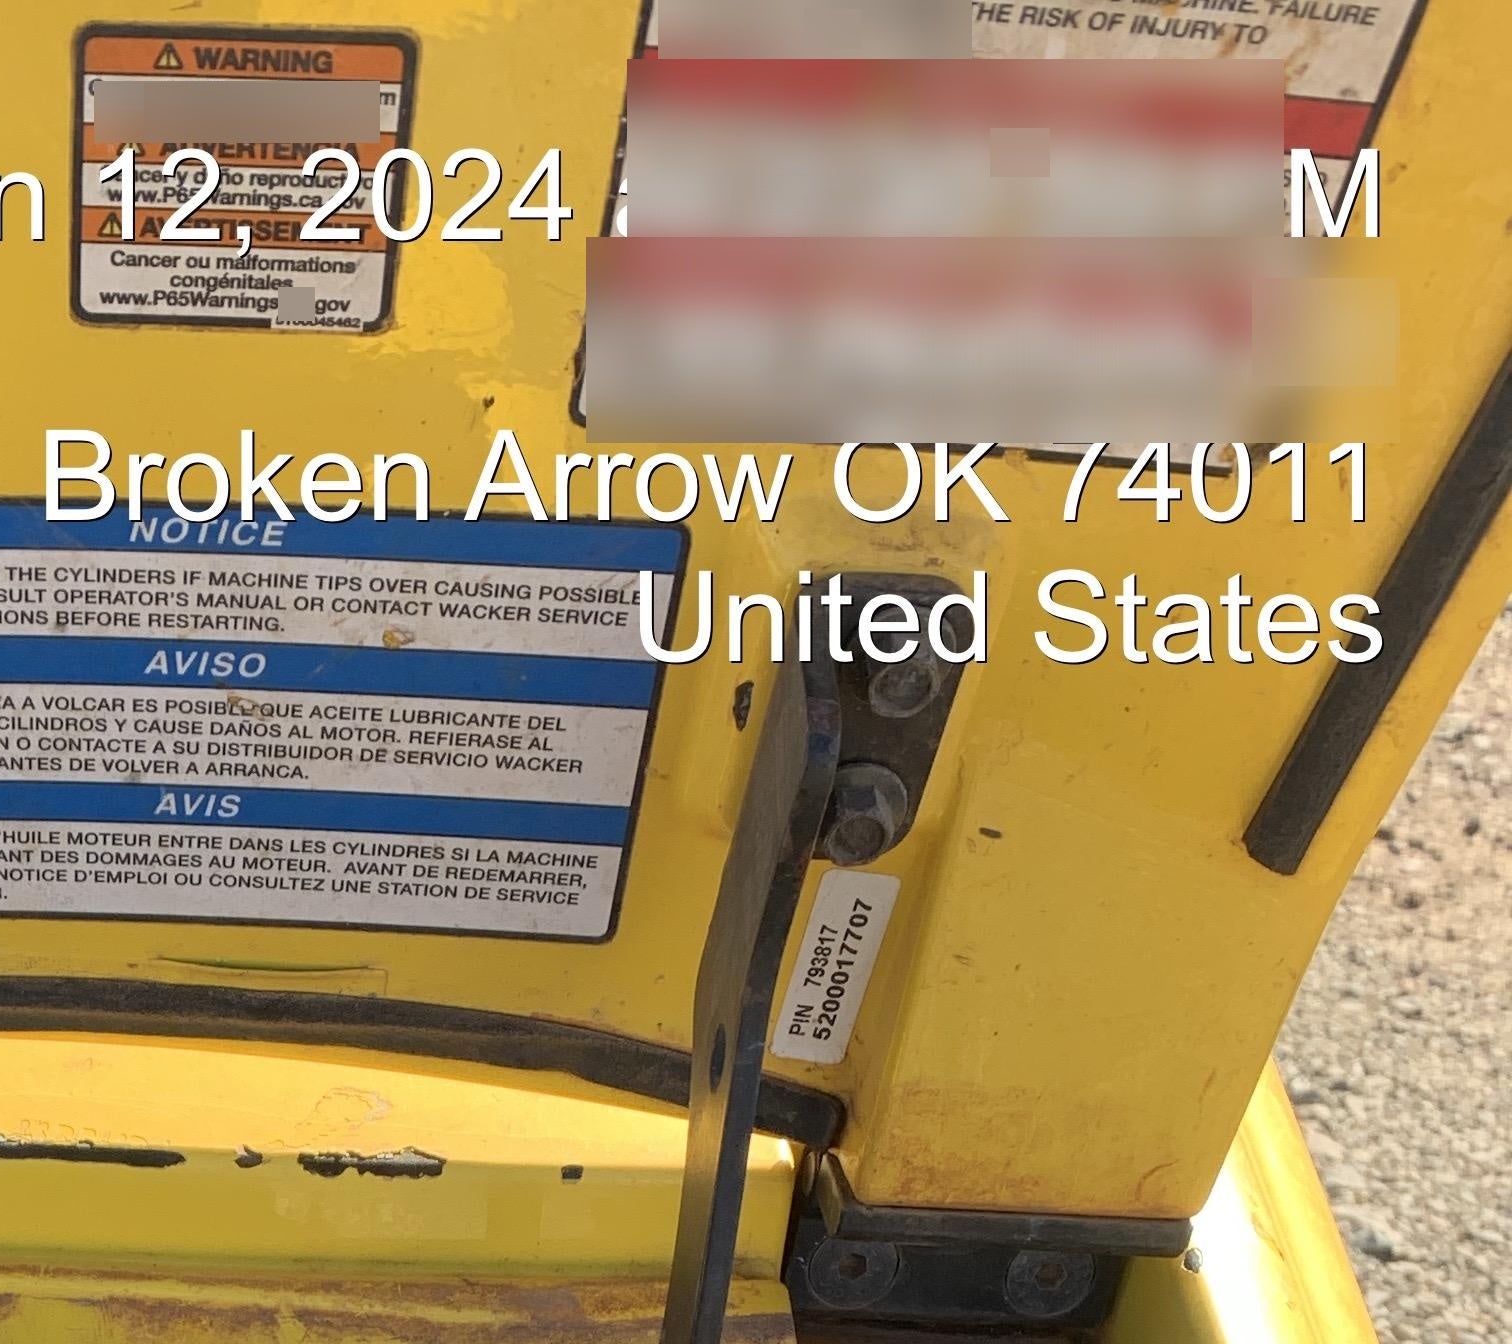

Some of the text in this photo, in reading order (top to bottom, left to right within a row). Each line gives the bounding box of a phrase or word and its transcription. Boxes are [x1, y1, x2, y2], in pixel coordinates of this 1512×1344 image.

[1019, 5, 1080, 29] RISK
[1088, 11, 1125, 31] OF
[1130, 16, 1224, 40] INJURY
[1234, 25, 1268, 45] TO
[1268, 0, 1380, 27] FAILURE
[194, 47, 333, 73] WARNING
[110, 251, 356, 275] Cancer ou malformations
[170, 274, 293, 293] congénitales
[129, 514, 287, 547] NOTICE
[4, 566, 46, 581] THE
[54, 567, 175, 584] CYLINDERS
[183, 570, 201, 585] IF
[209, 571, 308, 589] MACHINE
[315, 575, 362, 591] TIPS
[369, 578, 427, 594] OVER
[434, 581, 531, 600] CAUSING
[539, 585, 641, 608] POSSIBLE
[54, 589, 189, 606] OPERATOR'S
[197, 593, 287, 610] MANUAL
[294, 596, 324, 612] OR
[331, 598, 433, 616] CONTACT
[439, 603, 531, 621] WACKER
[538, 608, 628, 627] SERVICE
[56, 611, 140, 627] BEFORE
[148, 613, 284, 631] RESTARTING.
[144, 650, 267, 679] AVISO
[21, 696, 35, 710] A
[42, 696, 124, 712] VOLCAR
[133, 699, 158, 713] ES
[259, 703, 303, 719] QUE
[309, 705, 383, 722] ACEITE
[390, 709, 520, 729] LUBRICANTE
[528, 716, 567, 732] DEL
[114, 719, 127, 732] Y
[134, 719, 203, 735] CAUSE
[210, 715, 281, 737] DAÑOS
[288, 725, 313, 739] AL
[321, 726, 400, 743] MOTOR.
[409, 731, 522, 750] REFIERASE
[528, 737, 553, 751] AL
[17, 737, 31, 750] O
[38, 737, 146, 753] CONTACTE
[152, 740, 166, 754] A
[173, 741, 199, 755] SU
[207, 742, 352, 762] DISTRIBUIDOR
[359, 748, 388, 763] DE
[393, 750, 488, 768] SERVICIO
[496, 755, 583, 774] WACKER
[70, 758, 95, 771] DE
[102, 759, 179, 774] VOLVER
[186, 762, 198, 775] A
[205, 762, 308, 779] ARRANCA.
[154, 793, 242, 818] AVIS
[788, 924, 839, 1036] PIN 793817
[813, 898, 873, 1041] 5200017707
